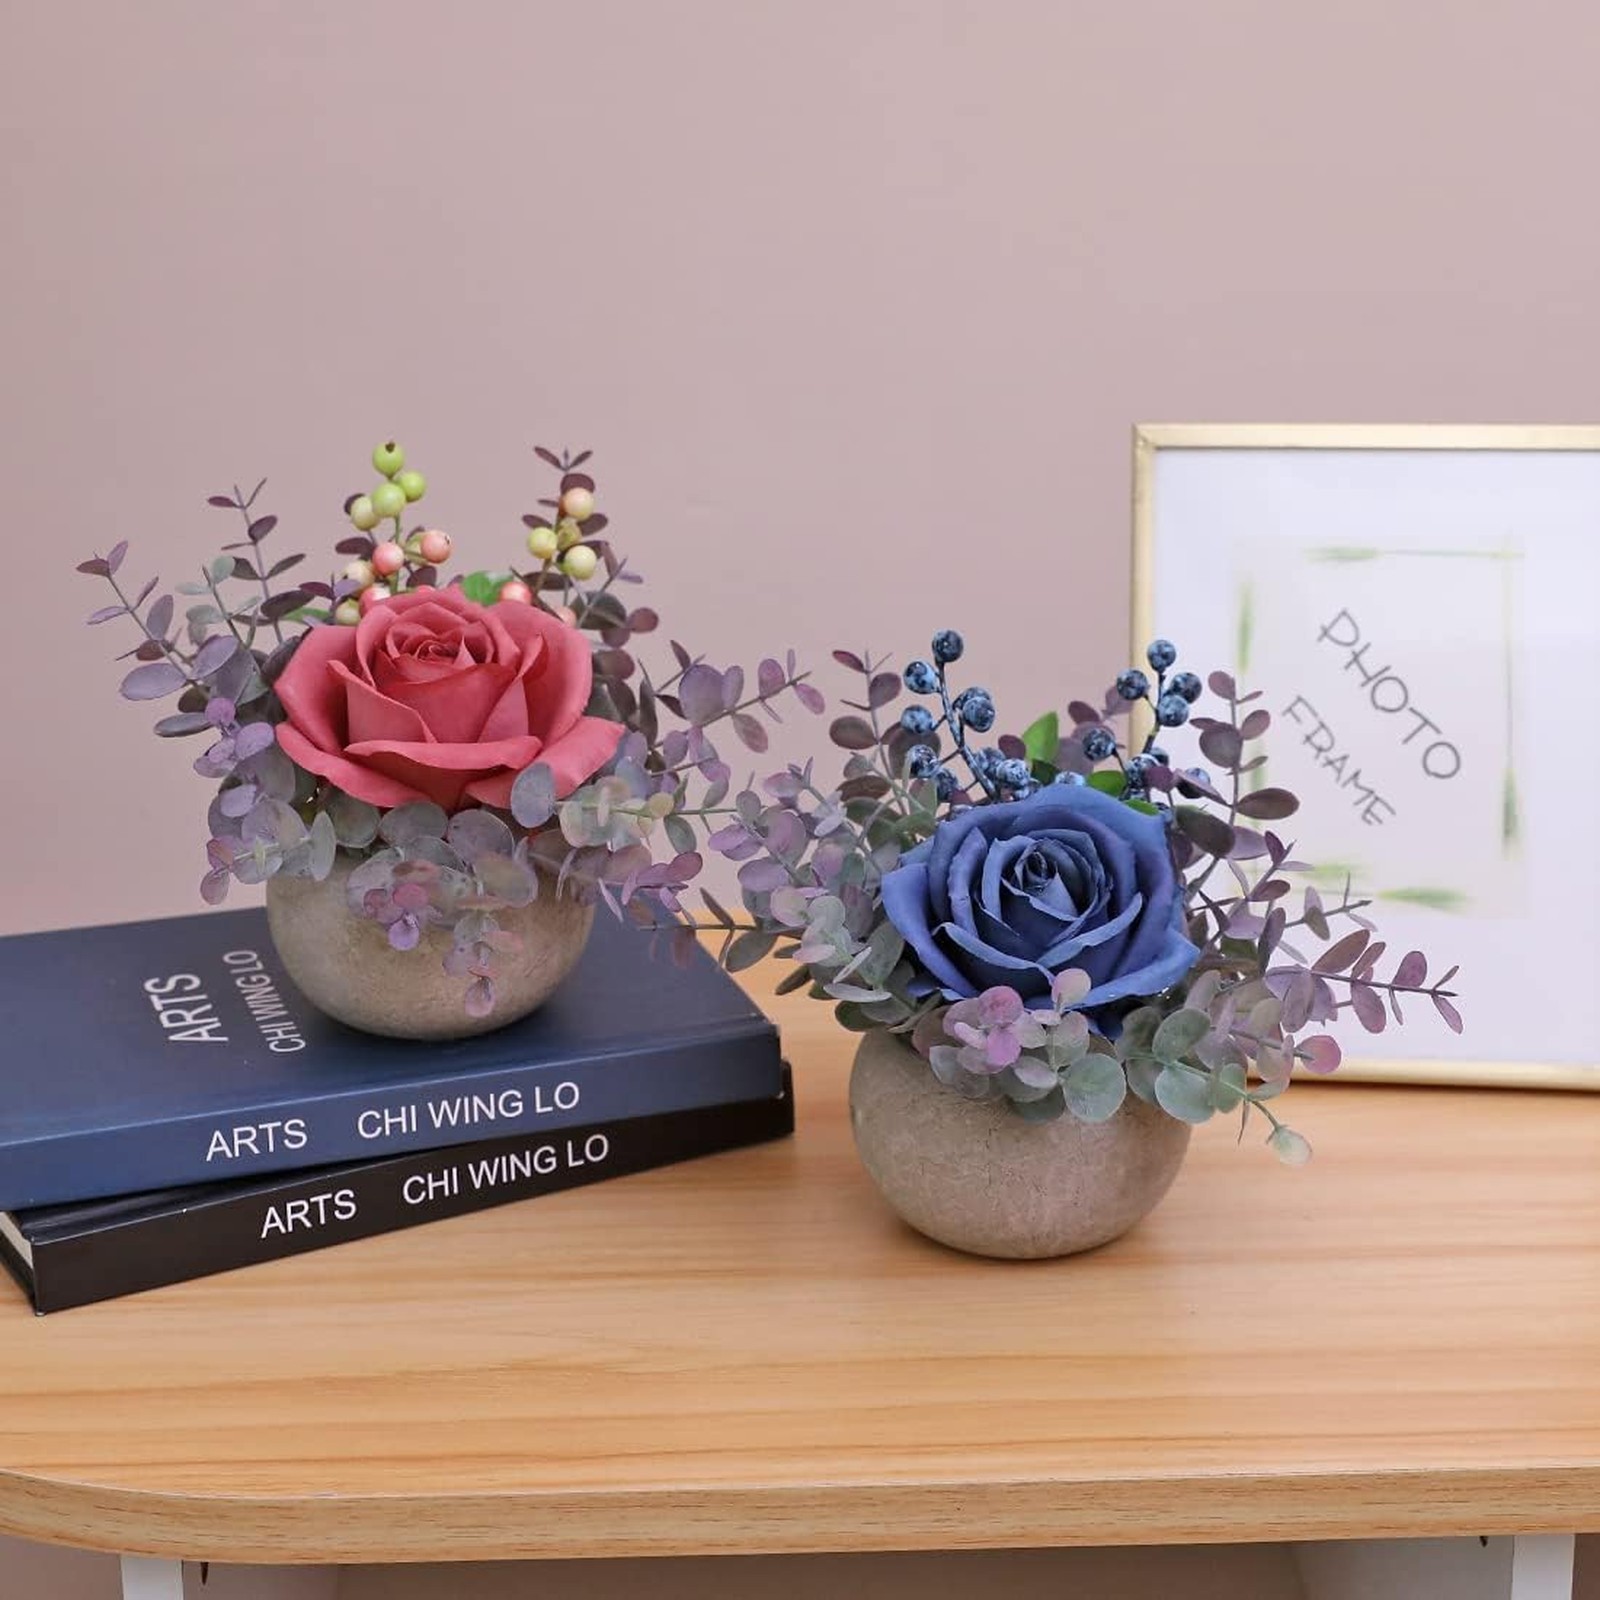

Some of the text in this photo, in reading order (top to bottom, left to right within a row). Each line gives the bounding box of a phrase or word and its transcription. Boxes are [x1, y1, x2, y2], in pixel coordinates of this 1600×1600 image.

[1317, 608, 1461, 779] PHOTO
[1282, 695, 1396, 825] FRAME
[144, 973, 229, 1042] ARTS
[222, 949, 306, 1053] CHI WING LO
[206, 1081, 580, 1162] ARTS CHI WING LO
[261, 1133, 609, 1239] ARTS CHI WING LO
